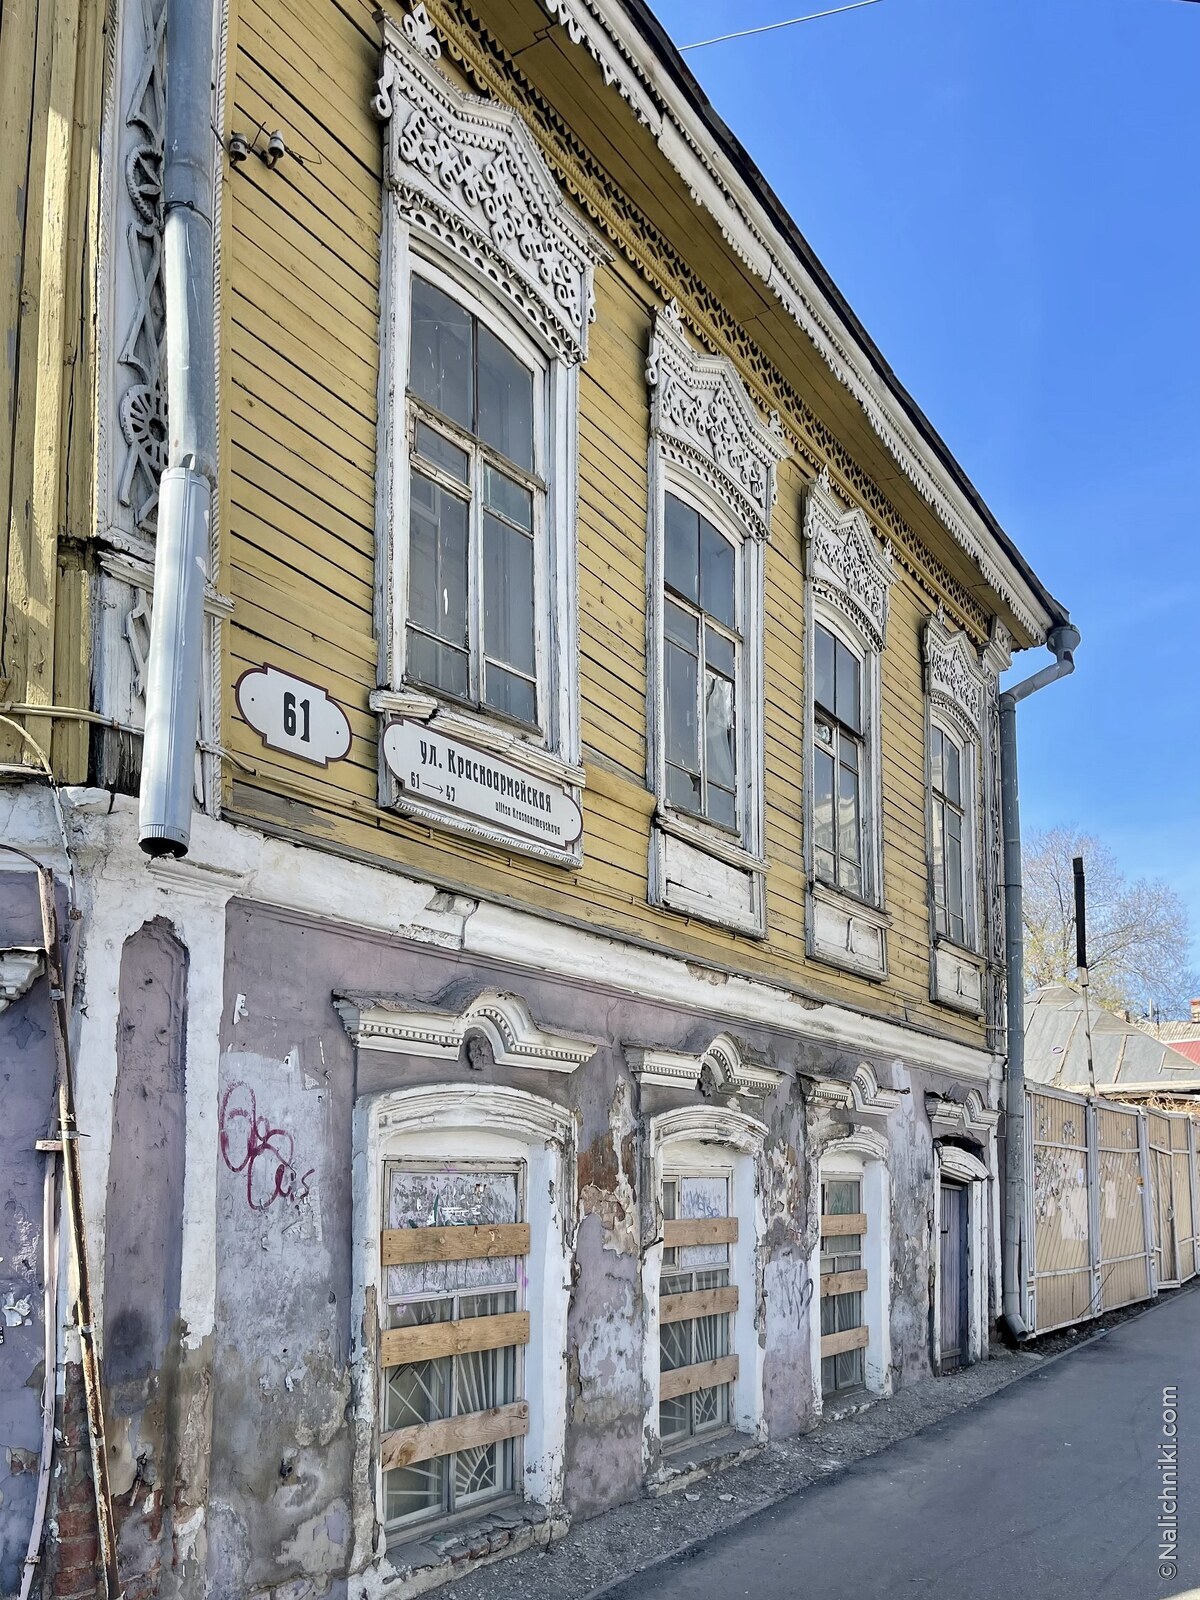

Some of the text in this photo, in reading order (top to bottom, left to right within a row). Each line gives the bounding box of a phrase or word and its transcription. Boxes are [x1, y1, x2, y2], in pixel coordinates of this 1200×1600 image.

[283, 691, 310, 743] 61
[410, 771, 456, 802] 61 47
[419, 739, 552, 813] ул. Красноармейская
[512, 807, 561, 836] Krasnoarmeyskaya
